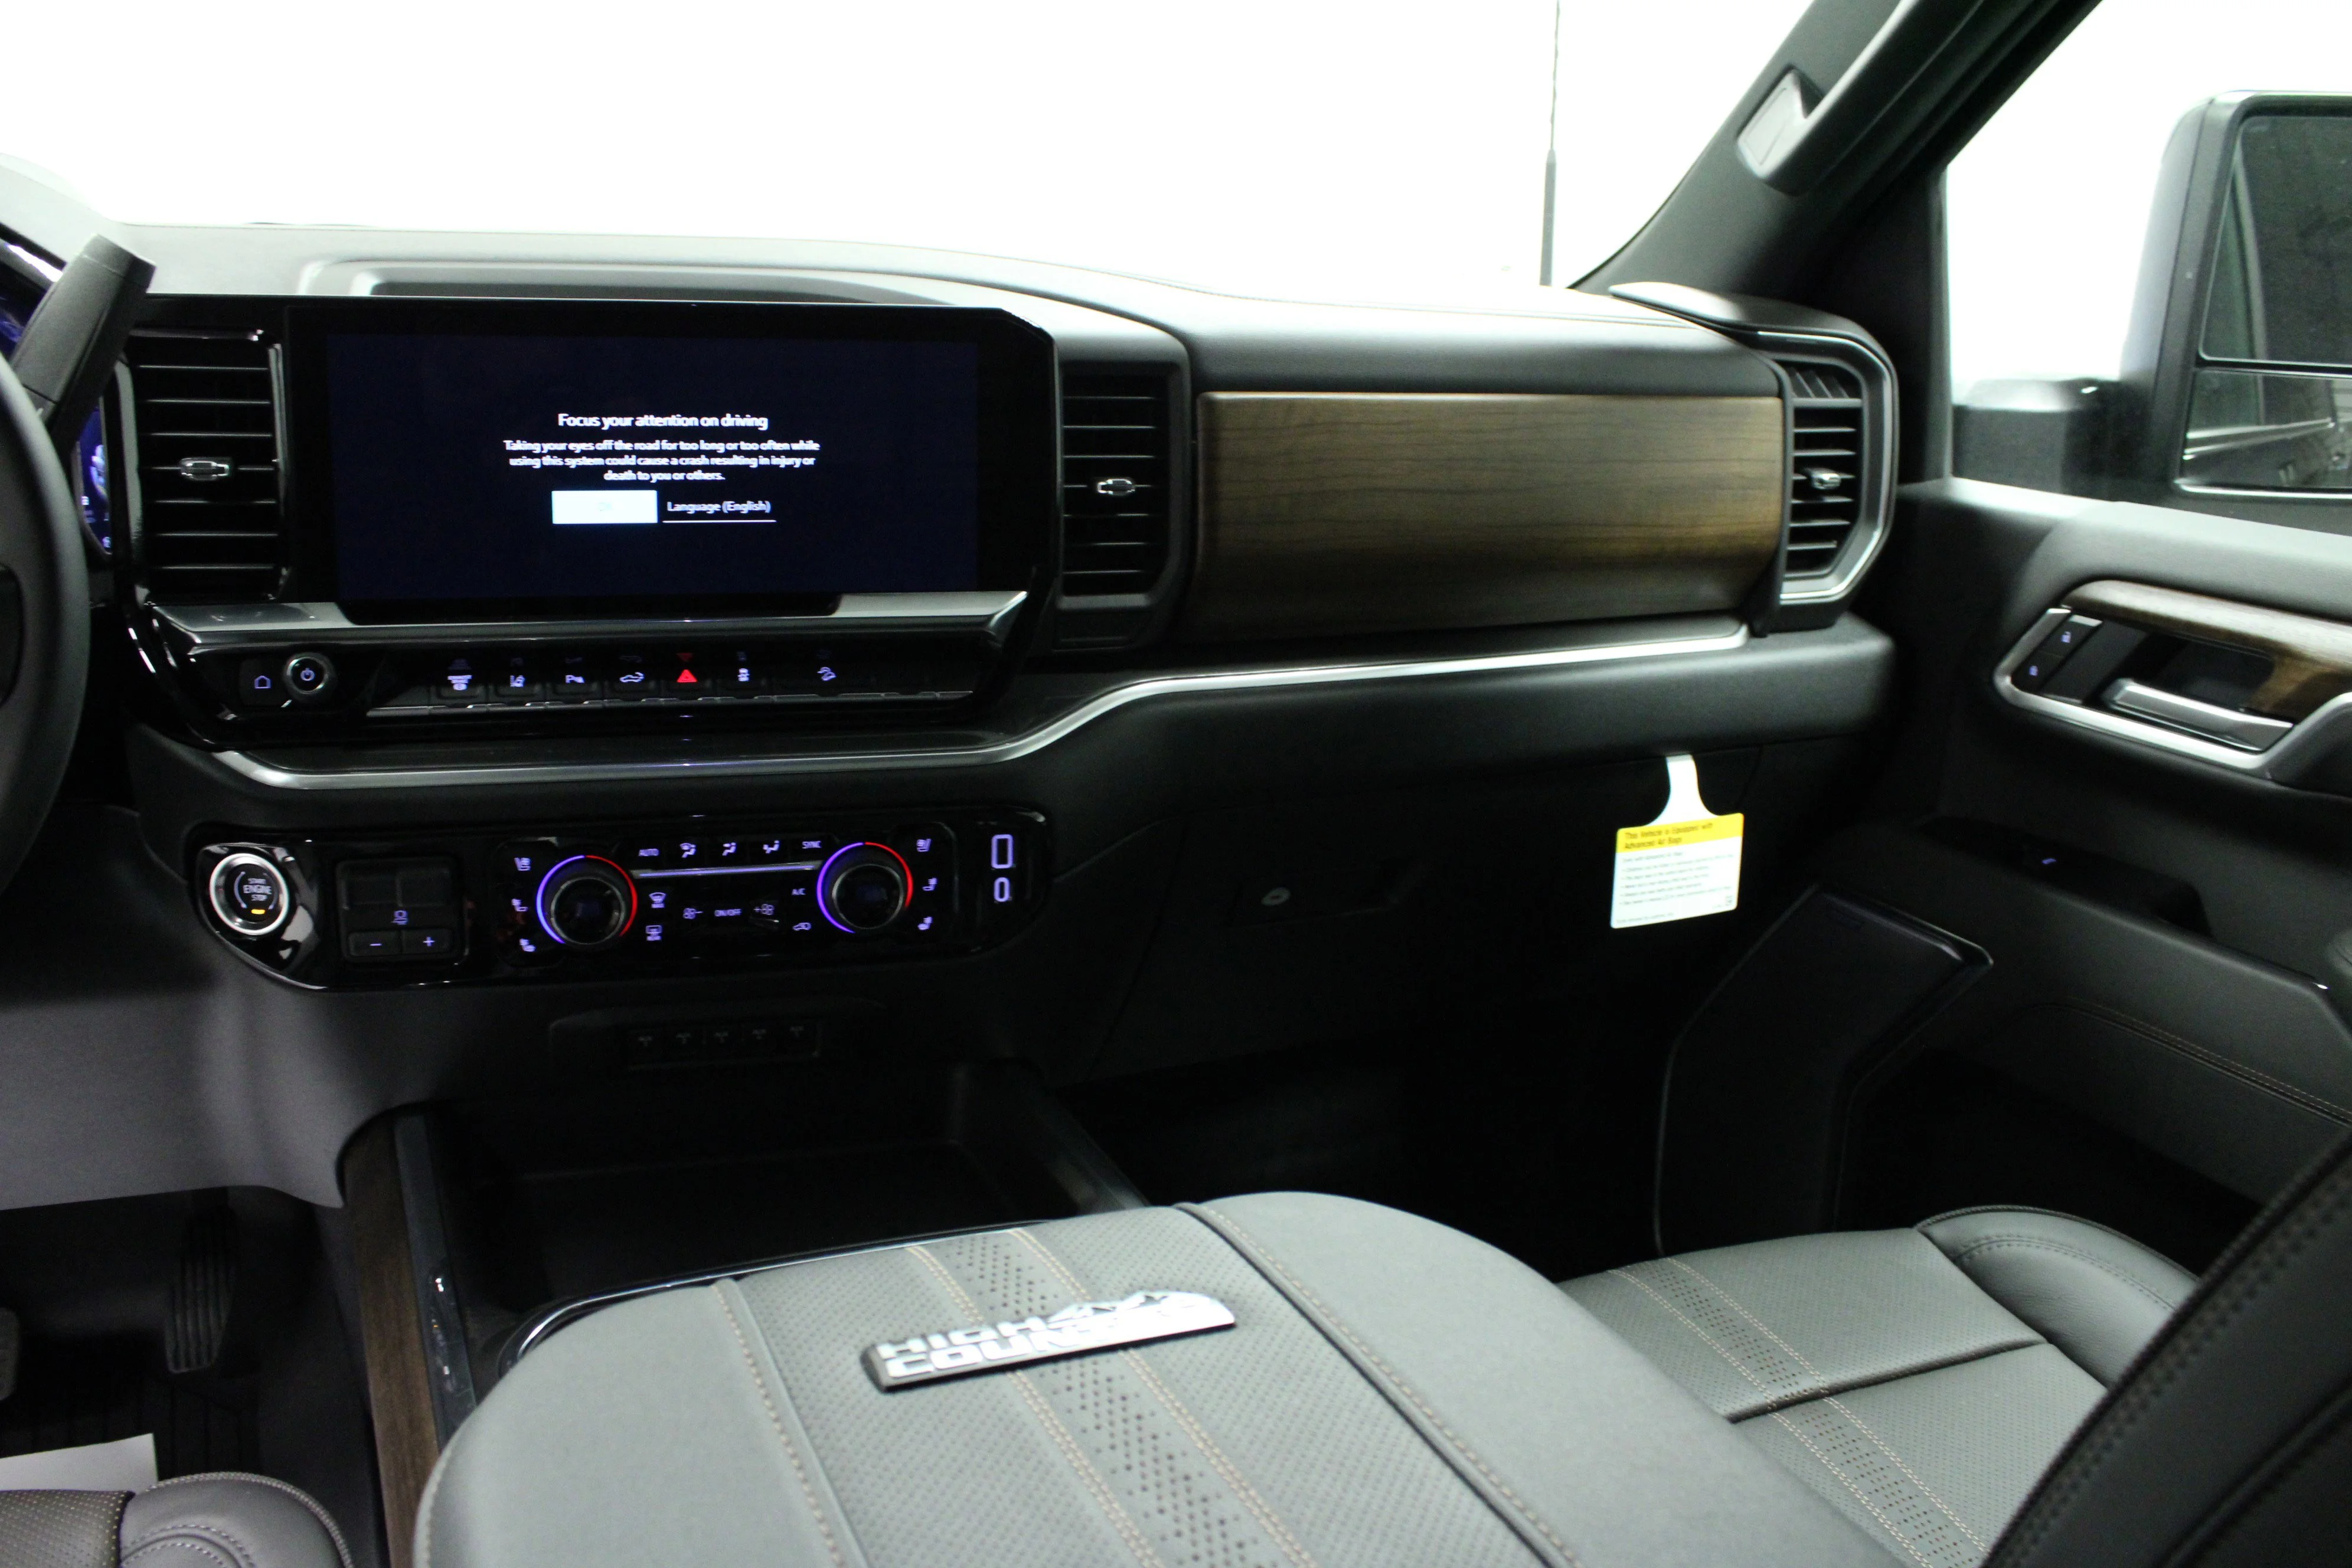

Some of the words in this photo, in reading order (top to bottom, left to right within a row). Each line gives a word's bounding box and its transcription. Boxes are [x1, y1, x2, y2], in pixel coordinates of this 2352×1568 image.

[558, 413, 601, 426] Focus
[601, 416, 634, 430] your
[635, 414, 699, 426] attention
[700, 416, 720, 426] on
[720, 413, 769, 430] driving
[504, 440, 541, 453] Taking
[541, 442, 568, 453] your
[568, 442, 595, 453] eyes
[595, 440, 614, 450] off
[614, 440, 633, 450] the
[634, 440, 661, 450] road
[661, 440, 679, 450] for
[679, 441, 699, 450] too
[700, 440, 726, 453] long
[740, 441, 760, 450] too
[760, 440, 790, 450] often
[790, 440, 820, 450] while
[509, 456, 541, 468] using
[541, 455, 564, 466] this
[564, 456, 605, 468] system
[605, 455, 636, 466] could
[636, 458, 669, 466] cause
[669, 458, 679, 466] a
[678, 455, 710, 465] crash
[710, 455, 758, 468] resulting
[758, 456, 770, 465] in
[770, 456, 802, 468] injury
[603, 470, 636, 481] death
[636, 472, 651, 481] to
[650, 473, 672, 483] you
[686, 470, 726, 481] others.
[667, 501, 720, 514] Language
[721, 500, 772, 514] (English)
[802, 840, 822, 849] SYNC
[243, 884, 272, 894] ENGINE
[791, 887, 806, 896] A/C
[875, 1316, 1048, 1360] HIGH
